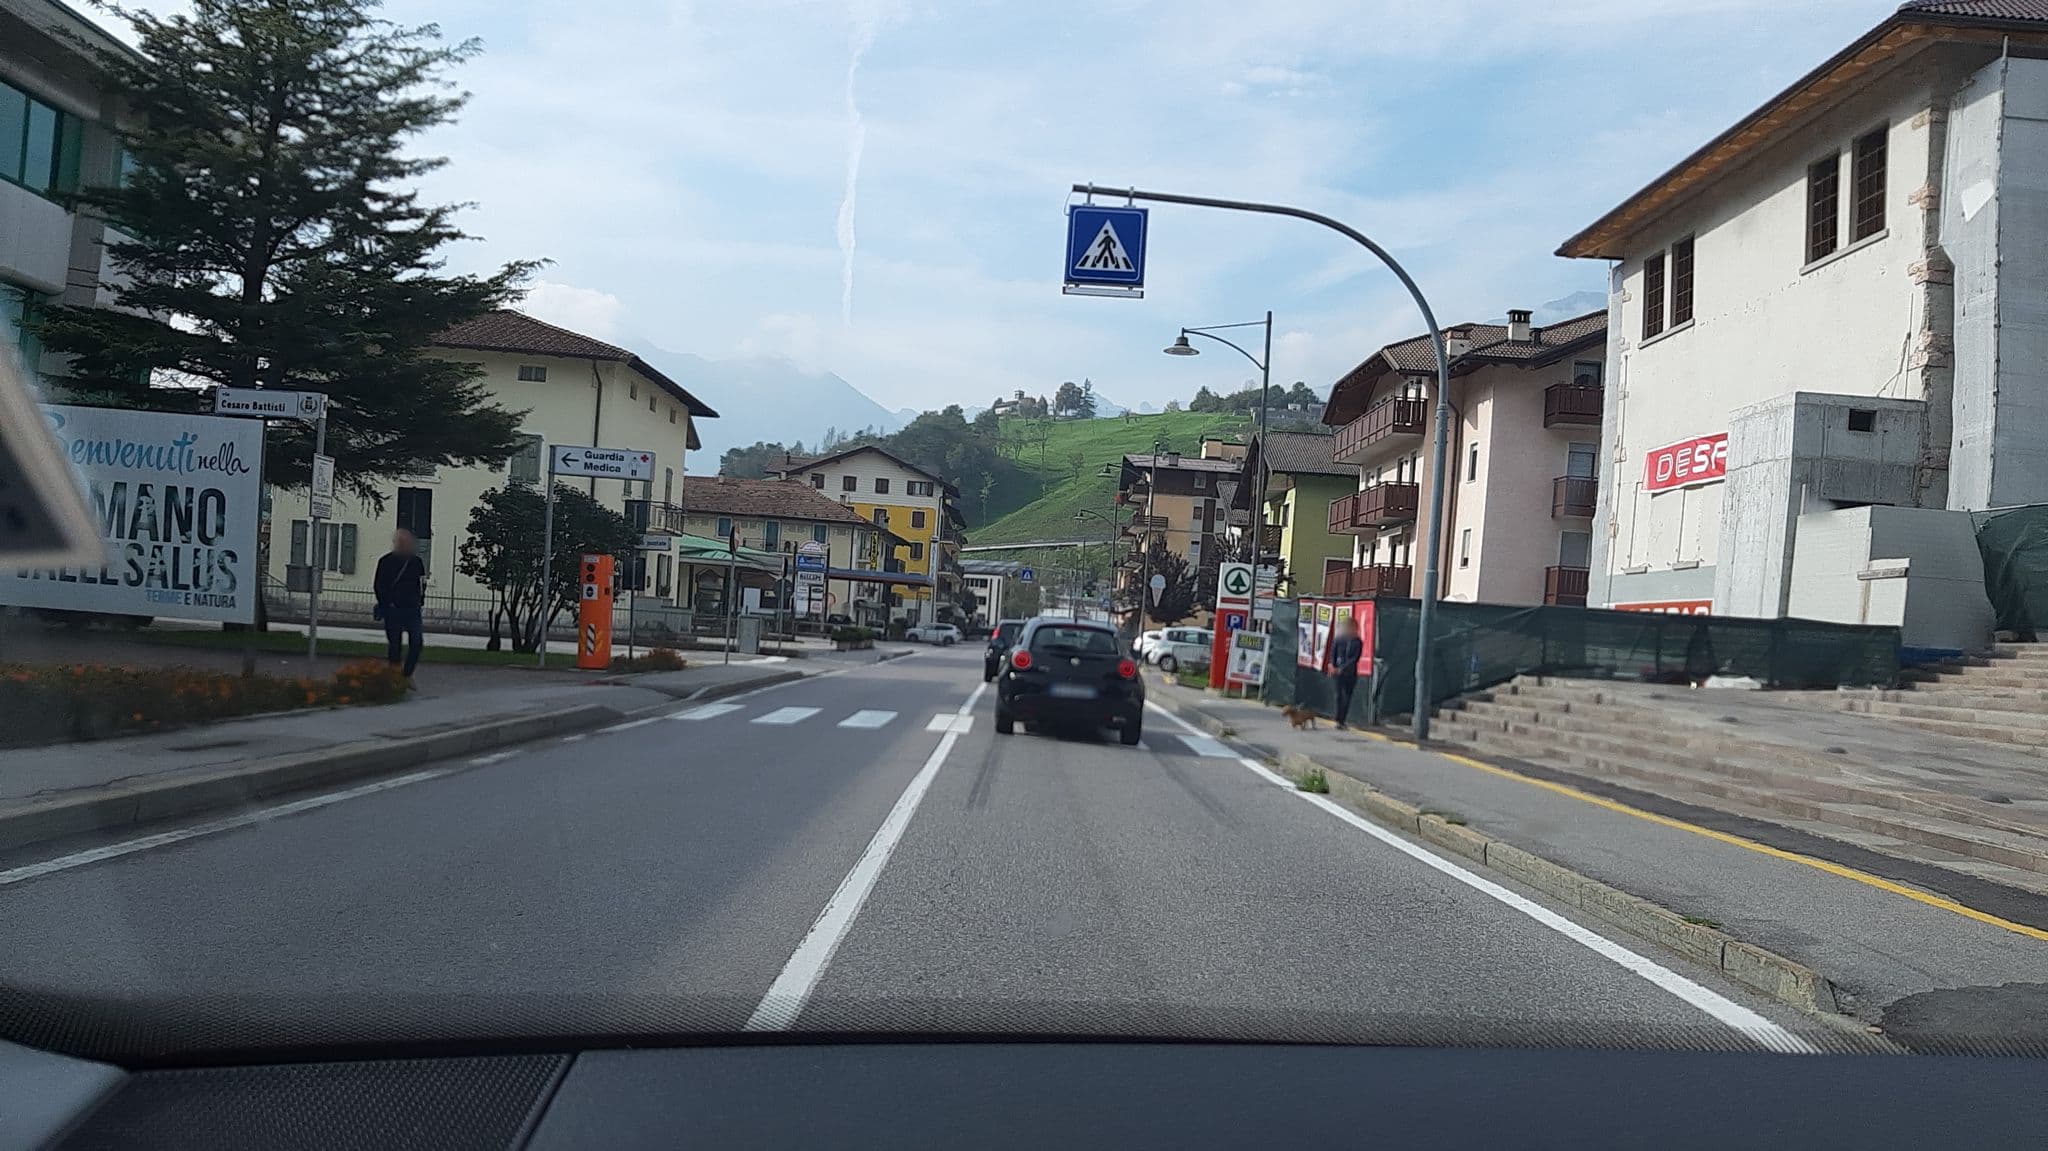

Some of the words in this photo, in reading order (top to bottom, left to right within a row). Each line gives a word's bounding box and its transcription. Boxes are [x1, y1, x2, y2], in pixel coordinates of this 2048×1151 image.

[252, 401, 287, 412] Battisti
[198, 441, 250, 476] nella
[584, 450, 625, 462] Guardia
[584, 462, 621, 473] Medica
[88, 481, 226, 546] MANO
[184, 592, 192, 606] E
[193, 593, 237, 609] NATURA
[1230, 615, 1241, 628] P
